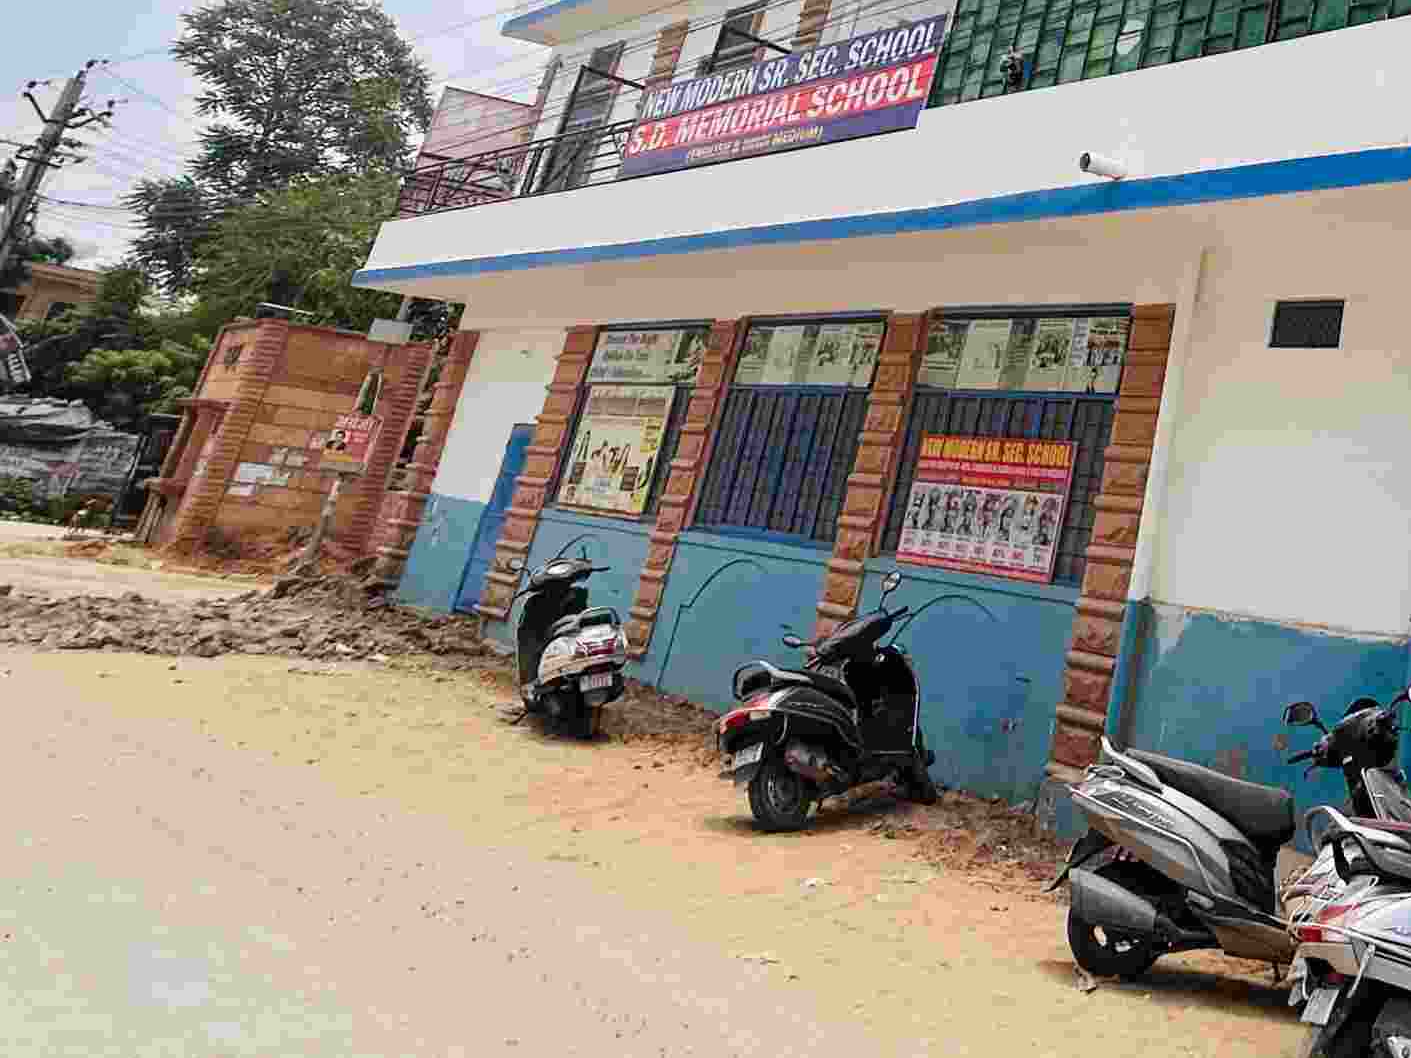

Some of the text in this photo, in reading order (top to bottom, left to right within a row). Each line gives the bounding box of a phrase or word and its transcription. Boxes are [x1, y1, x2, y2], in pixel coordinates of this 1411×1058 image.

[629, 65, 926, 155] S.D. MEMORIAL SCHOOL
[641, 21, 936, 119] NEW MODERN SR. SEC. SCHOOL
[1027, 441, 1072, 468] SCHOOL
